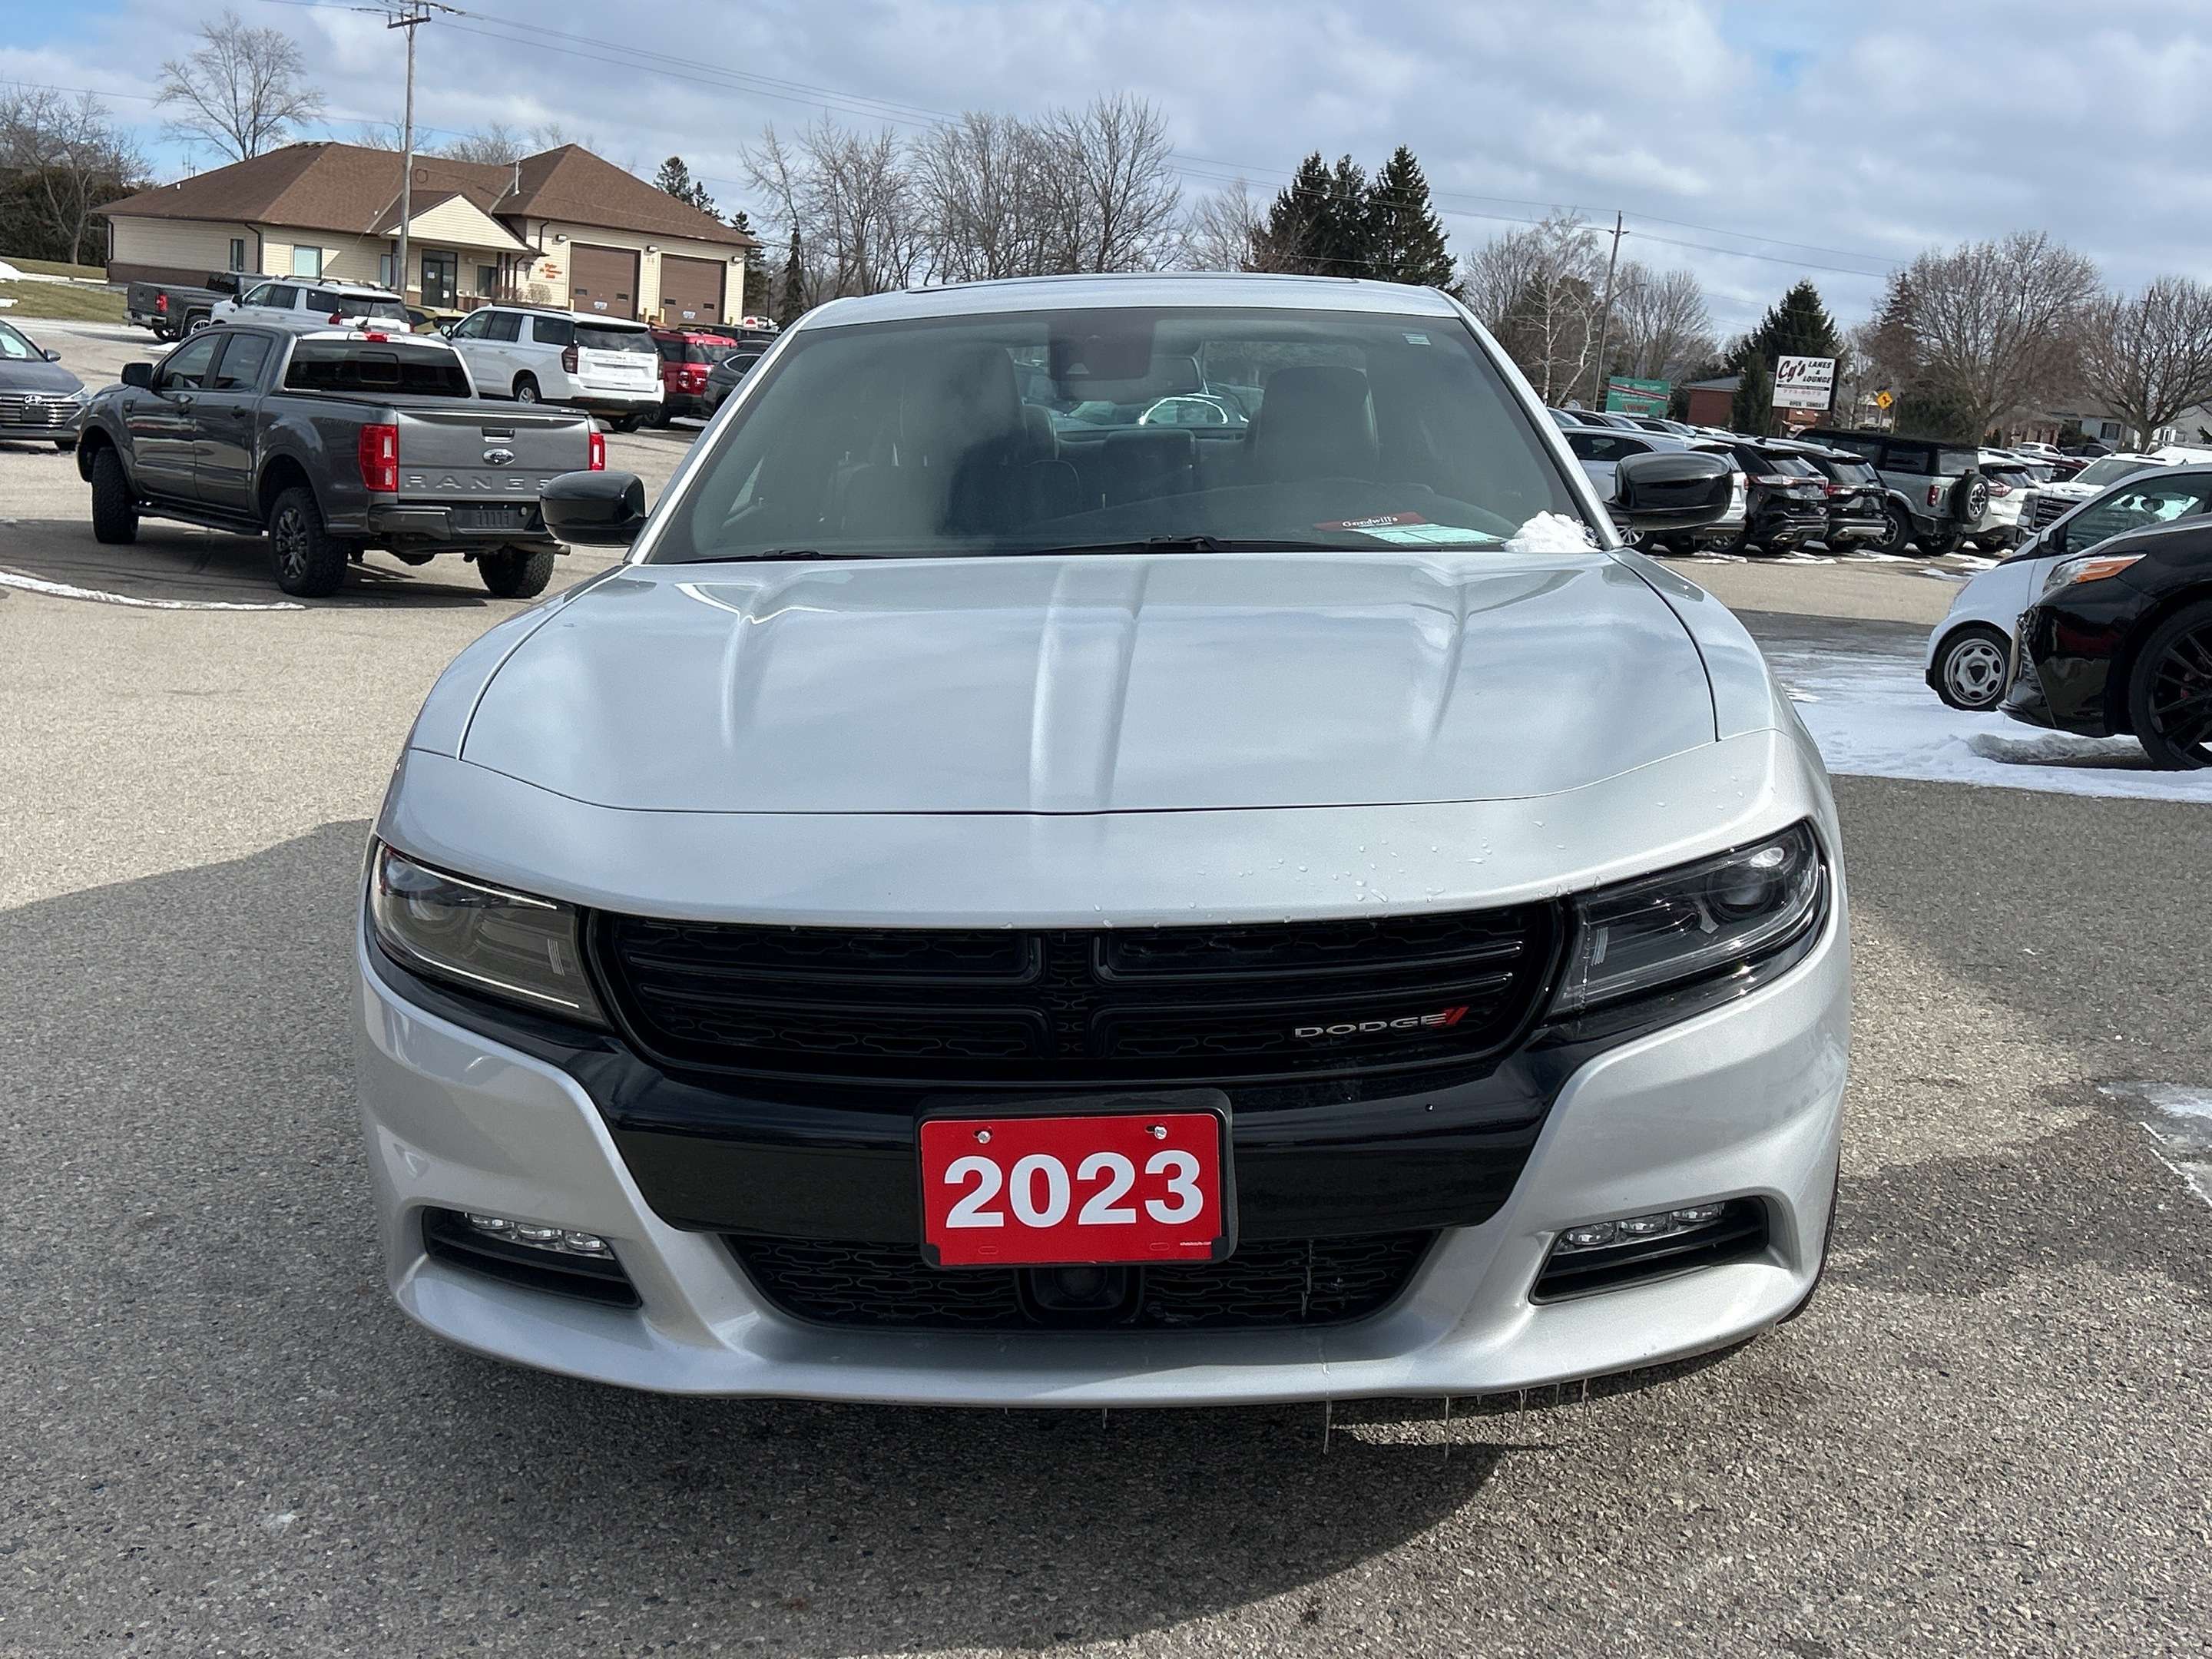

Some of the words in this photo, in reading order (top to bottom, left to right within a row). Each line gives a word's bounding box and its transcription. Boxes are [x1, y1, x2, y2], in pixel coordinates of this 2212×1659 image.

[1778, 360, 1806, 382] Cy's
[1294, 1012, 1447, 1038] DODGE
[944, 1149, 1204, 1229] 2023
